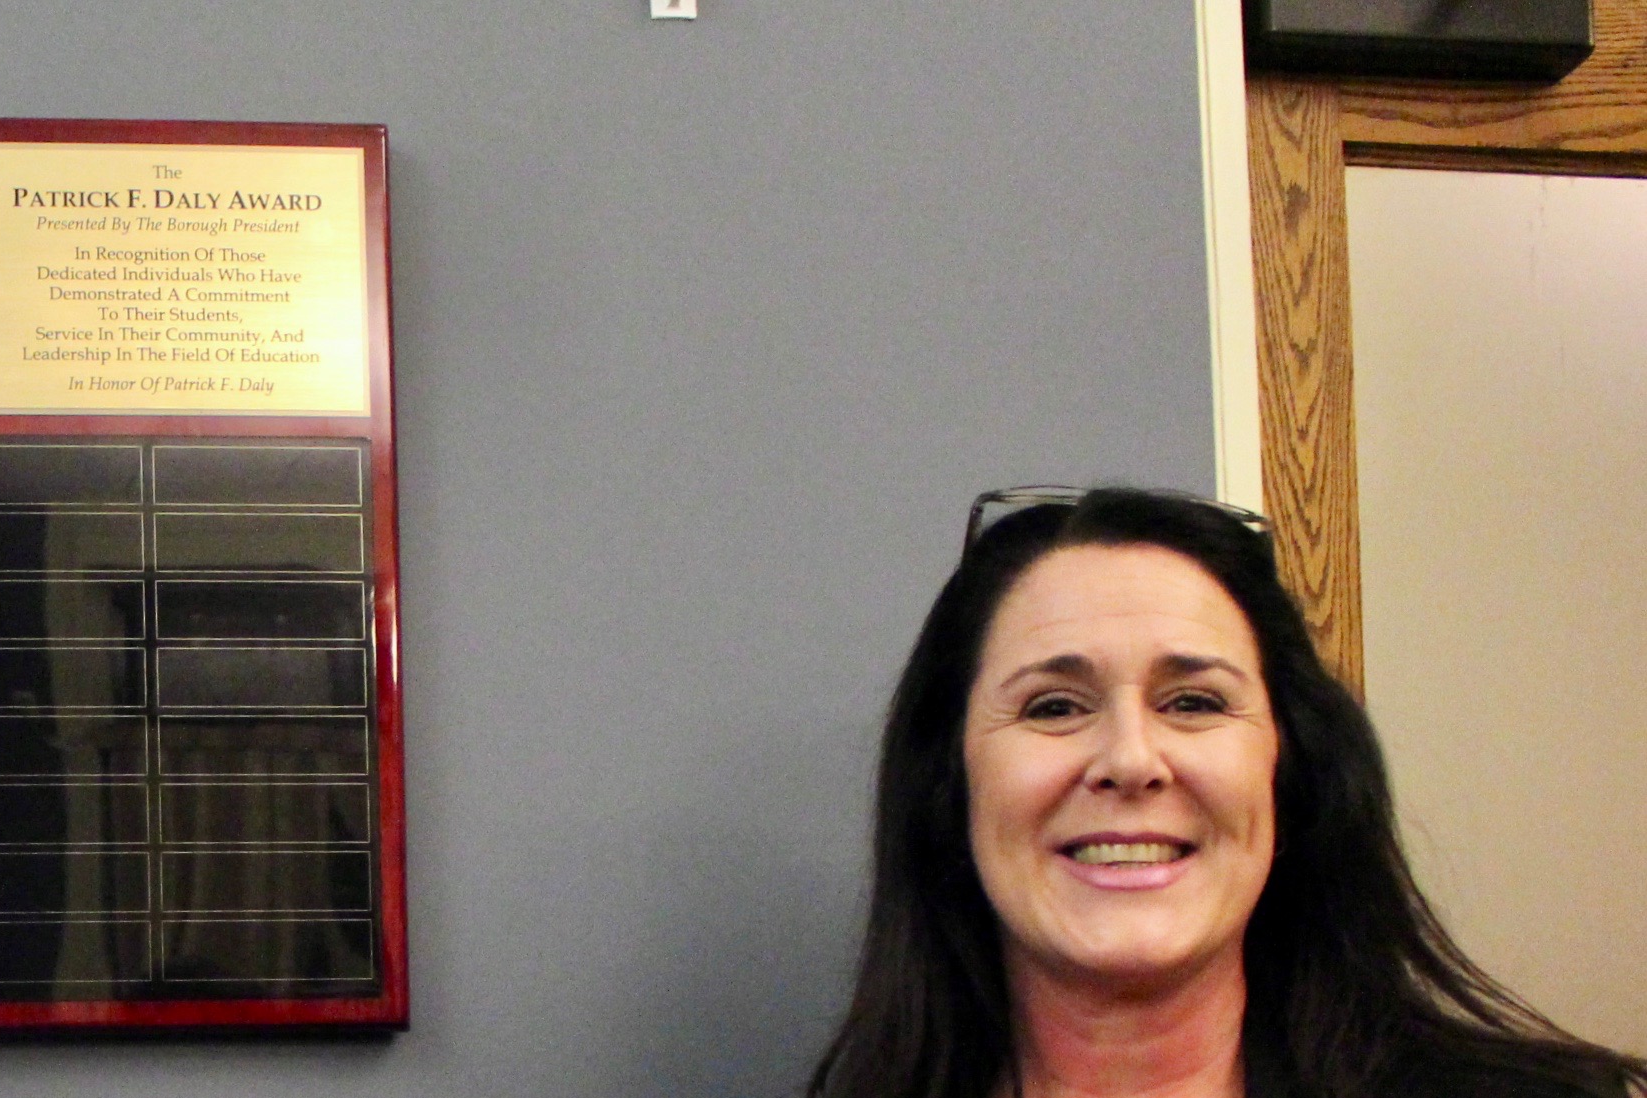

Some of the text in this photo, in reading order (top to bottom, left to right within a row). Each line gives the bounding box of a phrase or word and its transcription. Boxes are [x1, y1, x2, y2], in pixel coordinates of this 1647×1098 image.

[153, 165, 182, 180] The
[12, 188, 322, 211] PATRICK F. DALY AWARD
[36, 217, 299, 234] Presented By The Borough President
[75, 247, 266, 265] In Recognition Of Those
[37, 267, 302, 283] Dedicated Individuals Who Have
[49, 287, 290, 303] Demonstrated A Commitment
[98, 307, 243, 325] To Their Students,
[36, 327, 304, 346] Service In Their Community, And
[23, 347, 320, 366] Leadership In The Field Of Education
[68, 377, 274, 396] In Honor Of Patrick F. Daly
